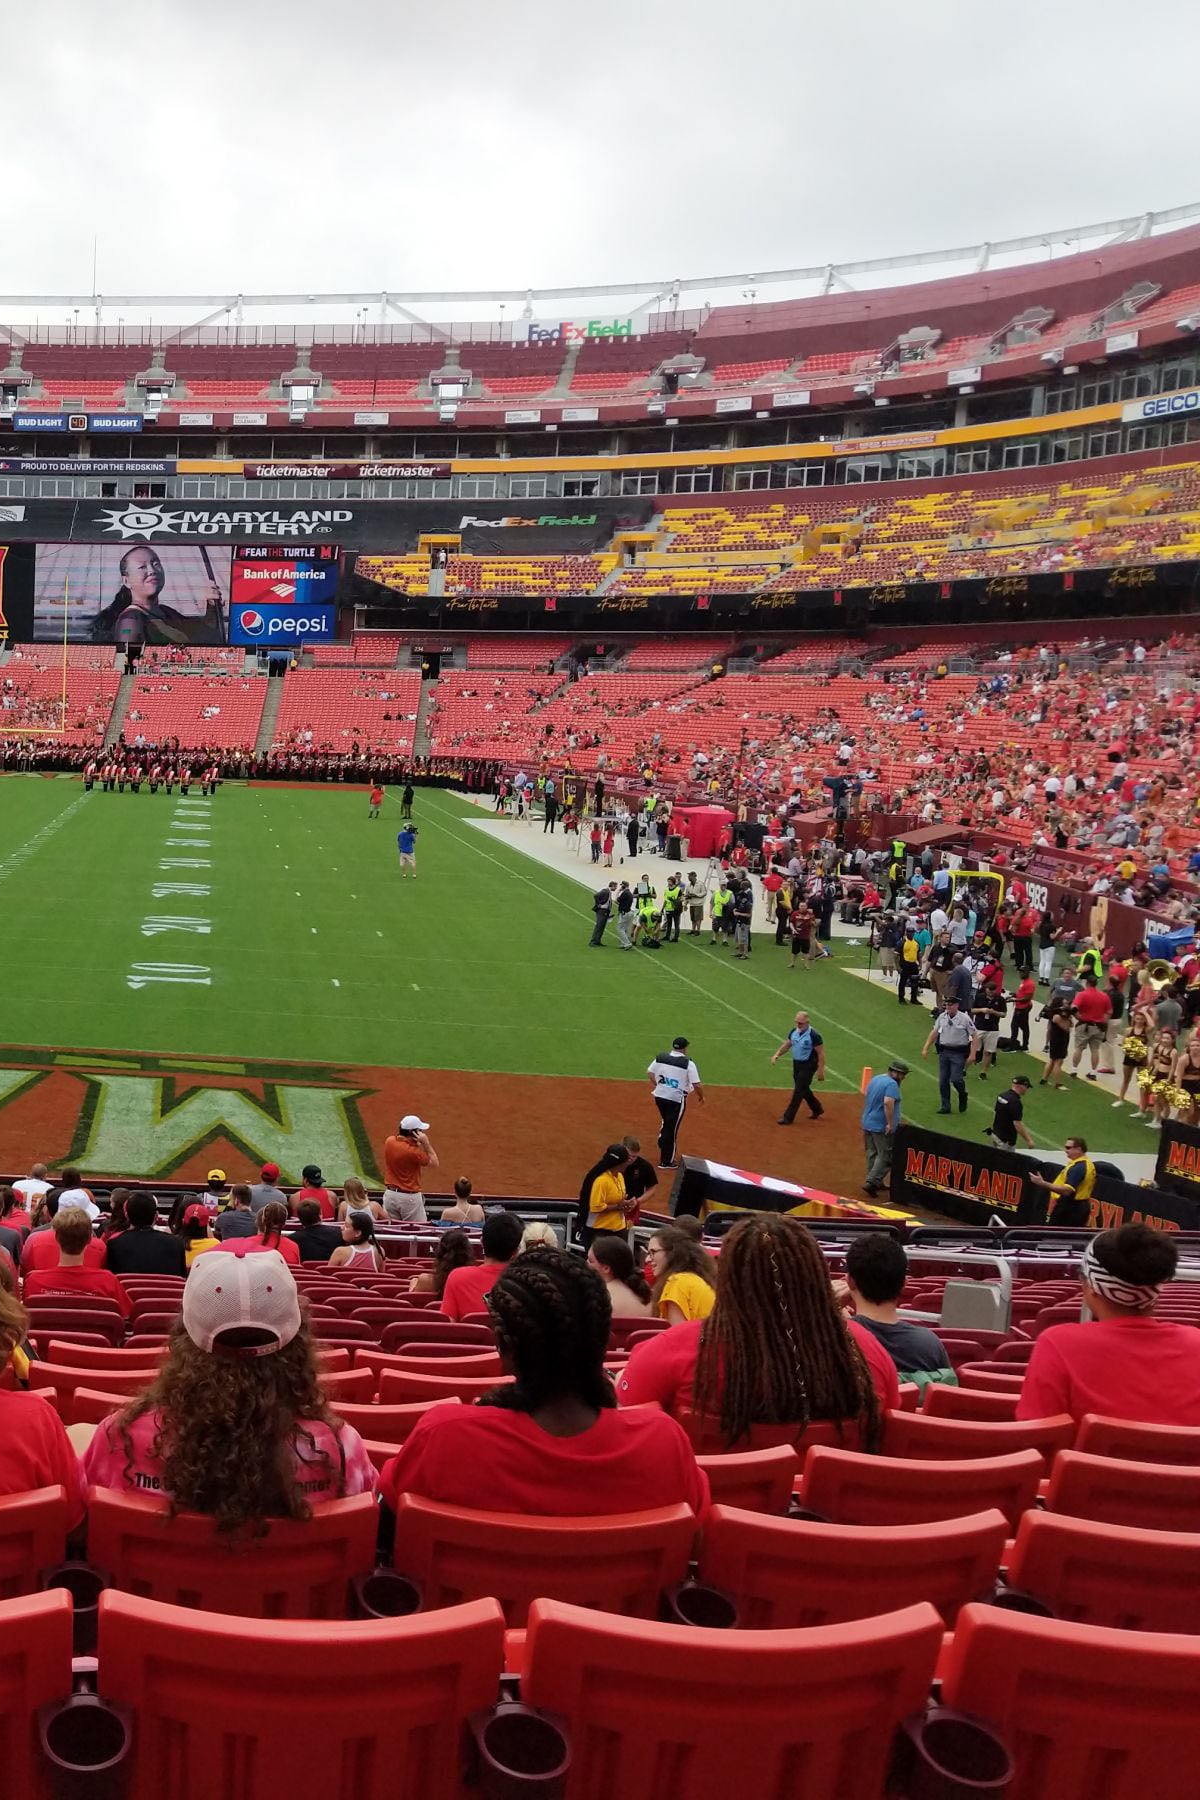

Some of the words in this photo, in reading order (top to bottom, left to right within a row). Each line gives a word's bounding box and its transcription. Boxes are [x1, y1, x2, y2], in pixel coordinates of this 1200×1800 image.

[528, 319, 632, 341] FedExField
[1142, 394, 1200, 417] GEICO
[18, 418, 37, 426] BUD
[37, 418, 62, 427] LIGHT
[71, 417, 85, 428] 40
[93, 419, 112, 427] BUD
[112, 419, 138, 427] LIGHT
[21, 462, 49, 470] PROUD
[256, 464, 331, 476] ticketmaster
[359, 465, 436, 476] ticketmaster
[183, 510, 353, 522] MARYLAND
[459, 515, 597, 529] FedExField
[180, 522, 320, 535] LOTTERY
[240, 547, 315, 557] #FEARTHETURTLE
[243, 569, 269, 580] Bank
[270, 568, 281, 580] of
[282, 569, 326, 580] America
[268, 615, 326, 636] pepsi
[1025, 881, 1048, 912] 1983
[141, 915, 212, 934] 20
[126, 962, 212, 985] 10
[905, 1147, 1023, 1206] MARYLAND
[134, 1472, 160, 1490] The
